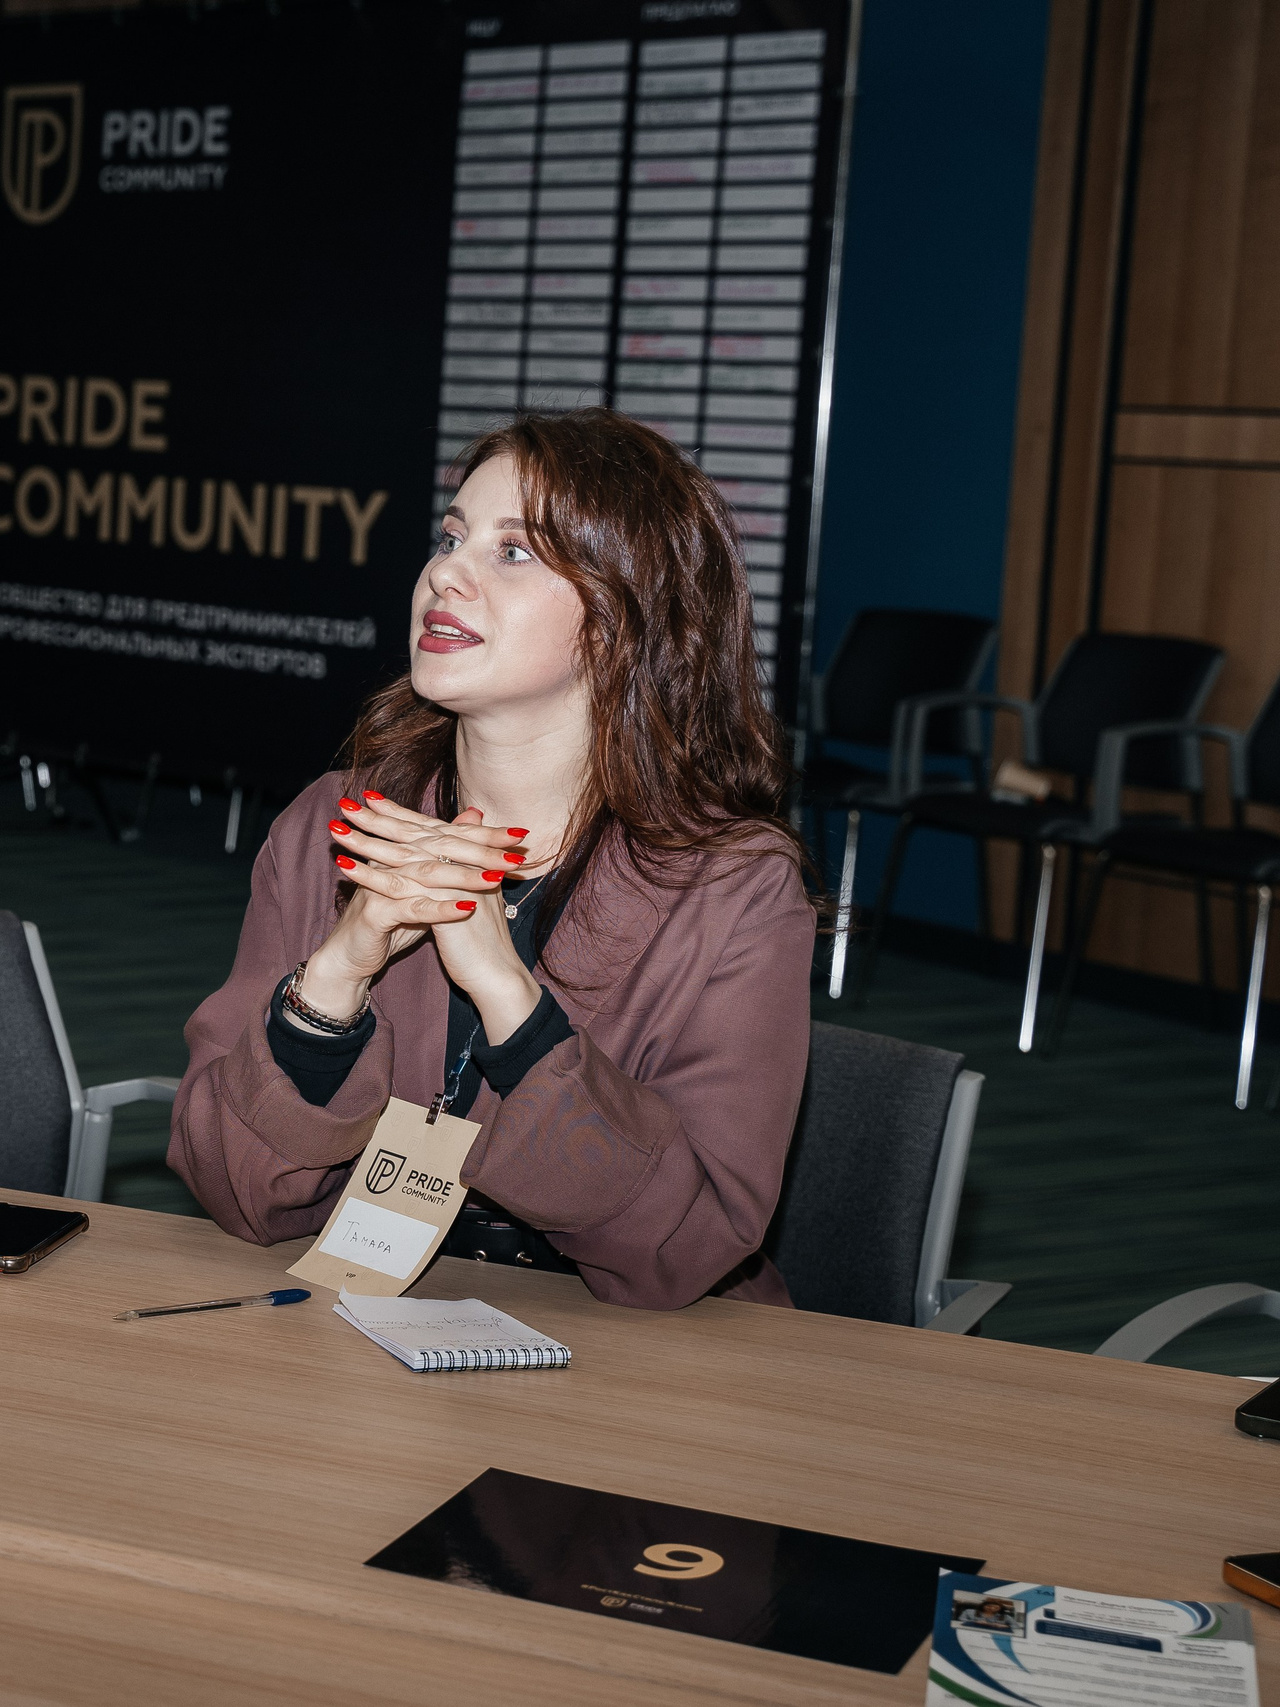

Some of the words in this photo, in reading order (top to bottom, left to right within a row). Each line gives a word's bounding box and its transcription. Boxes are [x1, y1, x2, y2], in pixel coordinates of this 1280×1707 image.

[101, 106, 231, 159] PRIDE
[99, 163, 229, 193] COMMUNITY
[401, 1185, 447, 1206] COMMUNITY
[406, 1169, 454, 1197] PRIDE
[633, 1543, 725, 1580] 9
